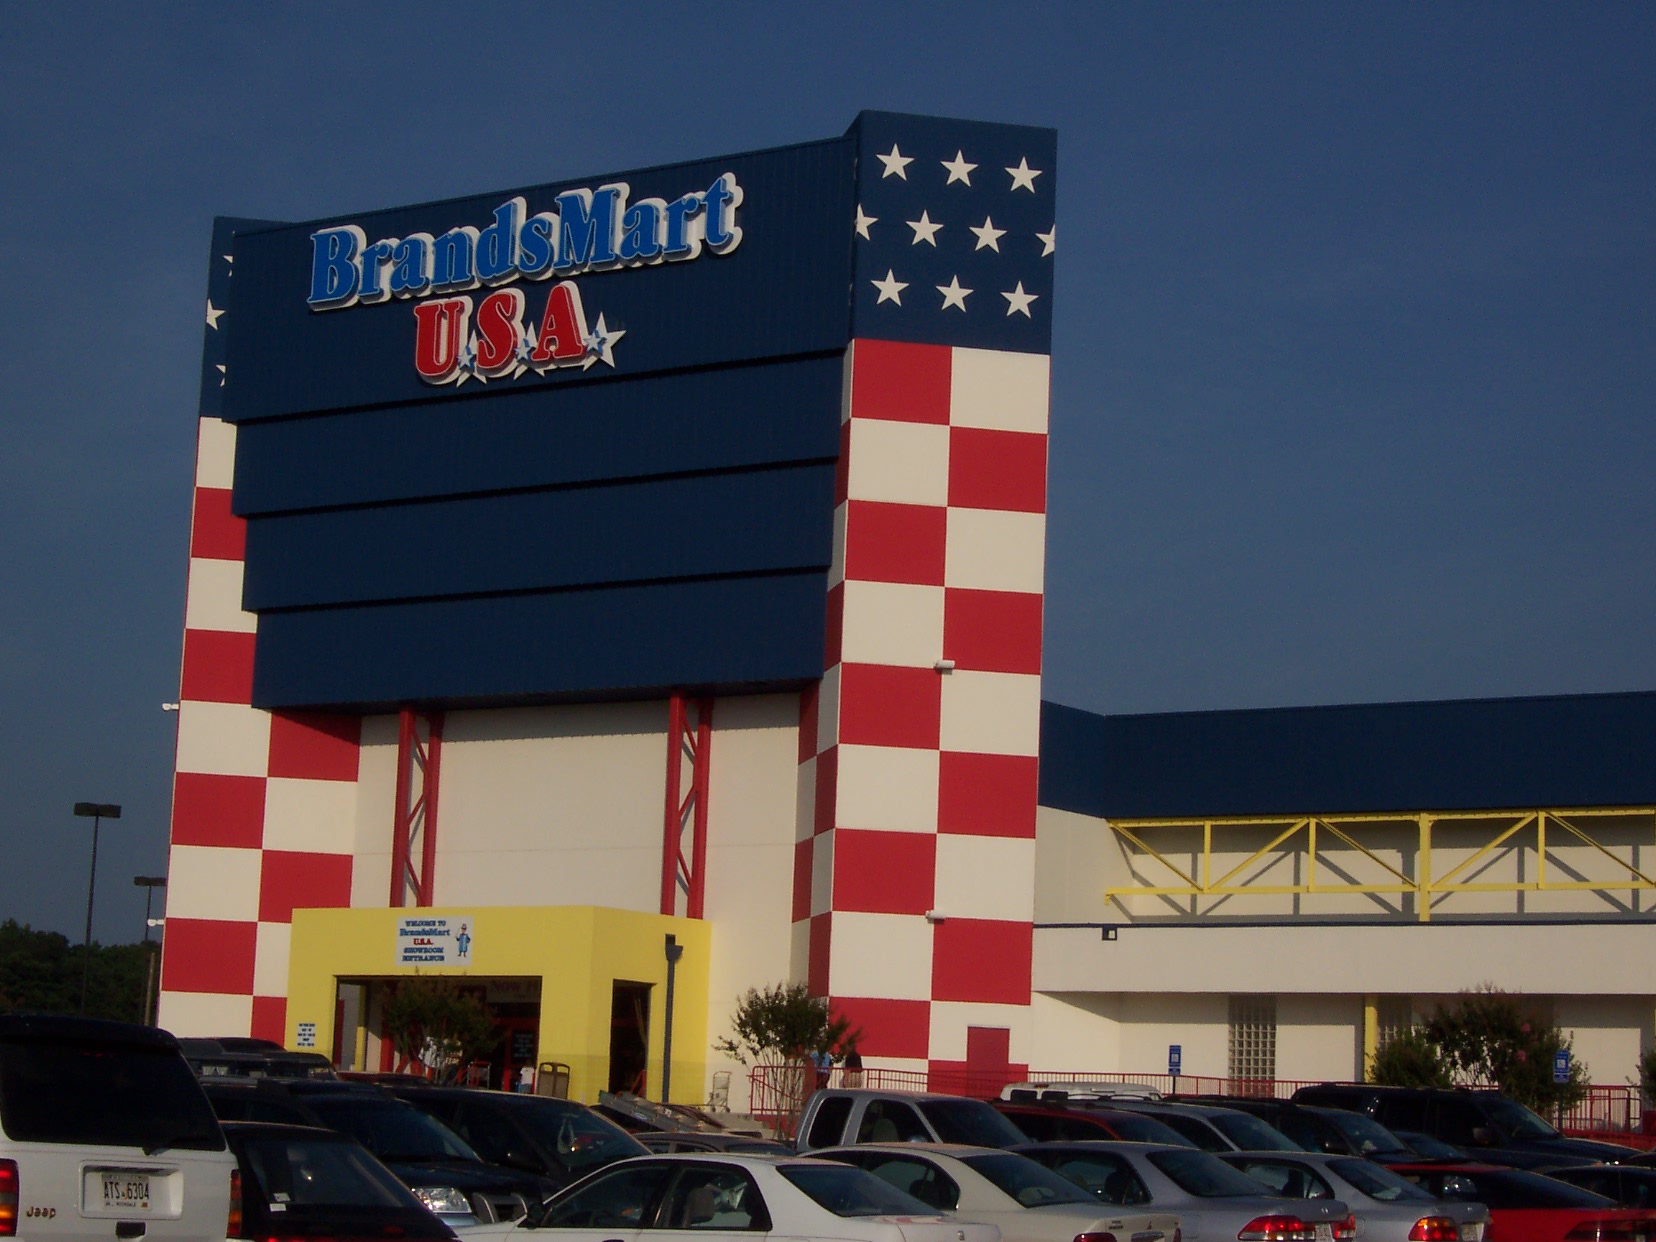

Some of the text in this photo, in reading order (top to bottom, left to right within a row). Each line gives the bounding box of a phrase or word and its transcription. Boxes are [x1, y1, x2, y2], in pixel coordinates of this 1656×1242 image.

[307, 174, 742, 308] BrandsMart
[399, 928, 451, 936] BrandsMart
[26, 1206, 56, 1219] Jeep
